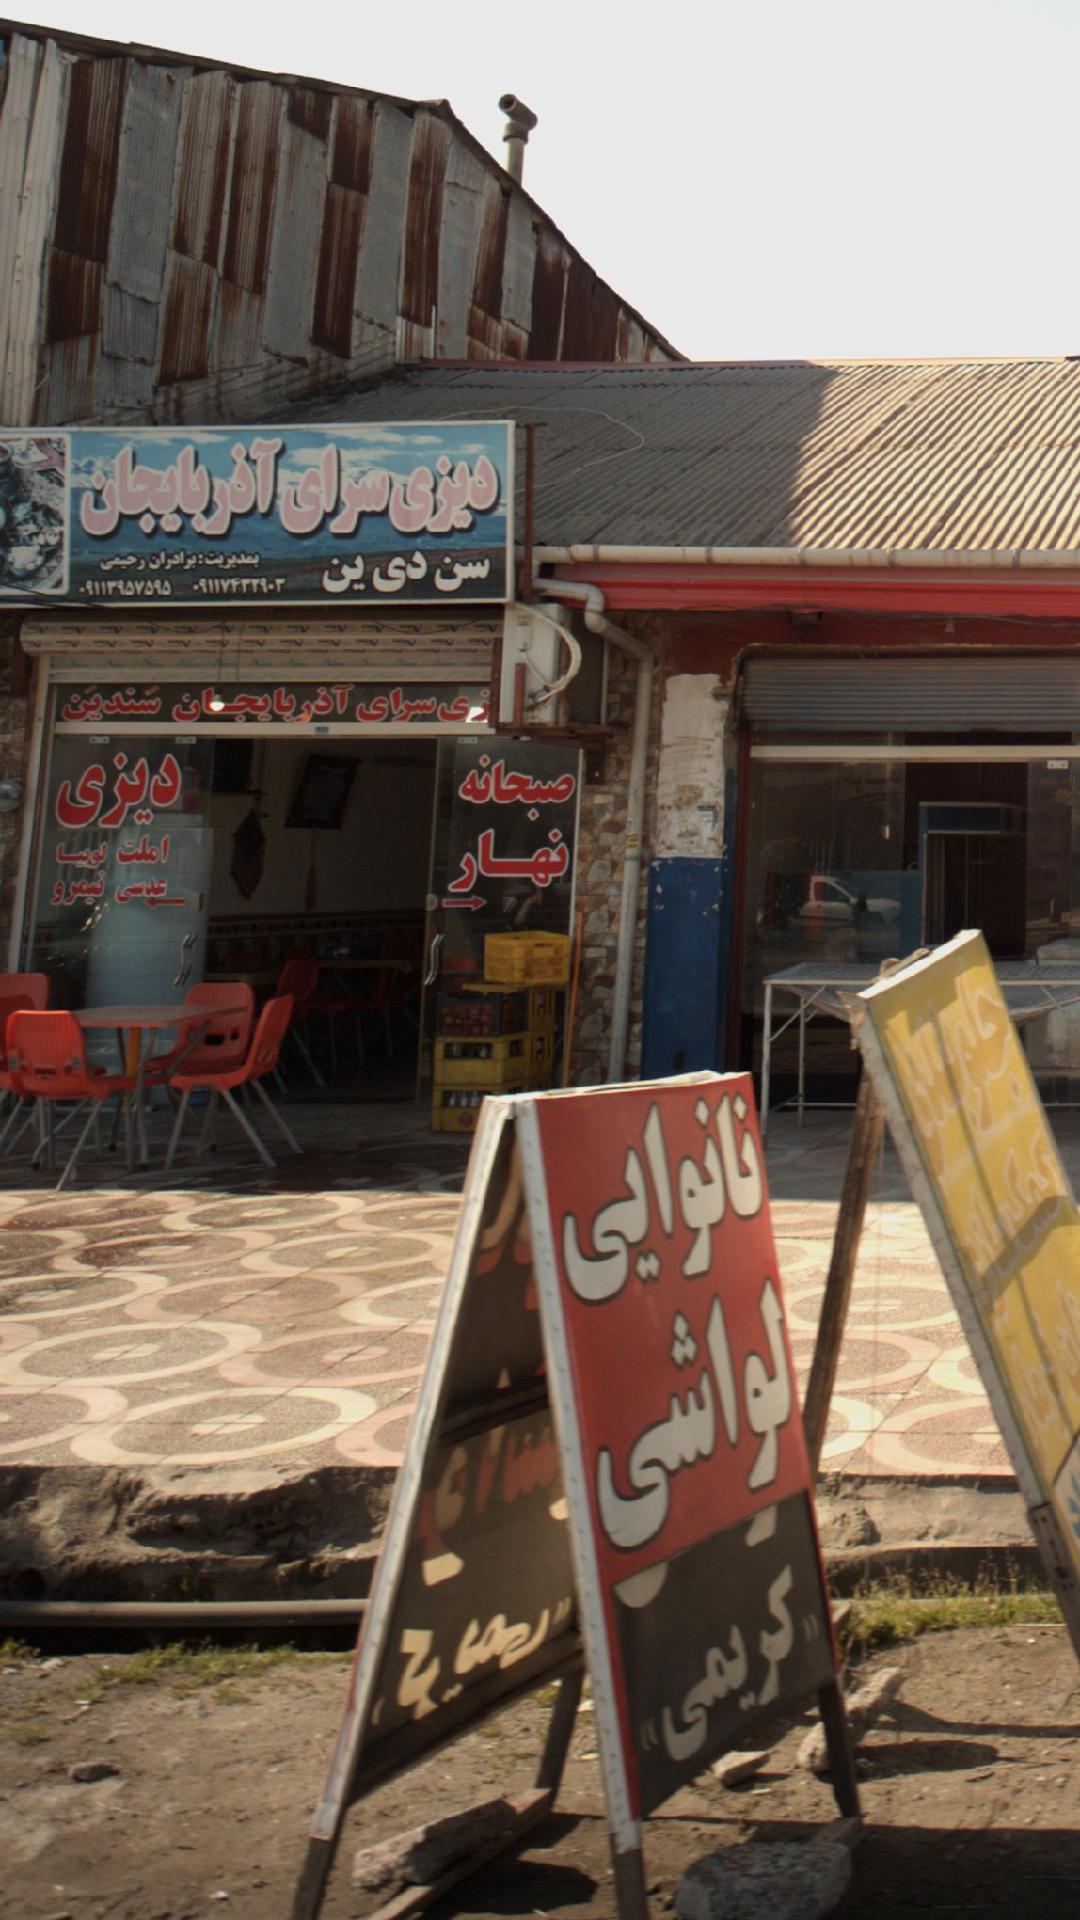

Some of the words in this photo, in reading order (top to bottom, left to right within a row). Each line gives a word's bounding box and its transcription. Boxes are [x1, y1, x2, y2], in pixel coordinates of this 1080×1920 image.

[80, 437, 283, 536] آذربایجان
[280, 443, 391, 534] سرای
[389, 454, 498, 533] دیزی
[149, 551, 197, 570] برادران
[322, 555, 365, 593] ین
[373, 550, 428, 592] دی
[435, 556, 490, 592] سن
[356, 687, 437, 723] سرای
[56, 752, 182, 829] دیزی
[459, 754, 576, 821] صبحانه
[117, 834, 170, 864] املت
[448, 828, 570, 892] نهار
[562, 1091, 764, 1306] نانوایی
[595, 1276, 792, 1553] لواشی
